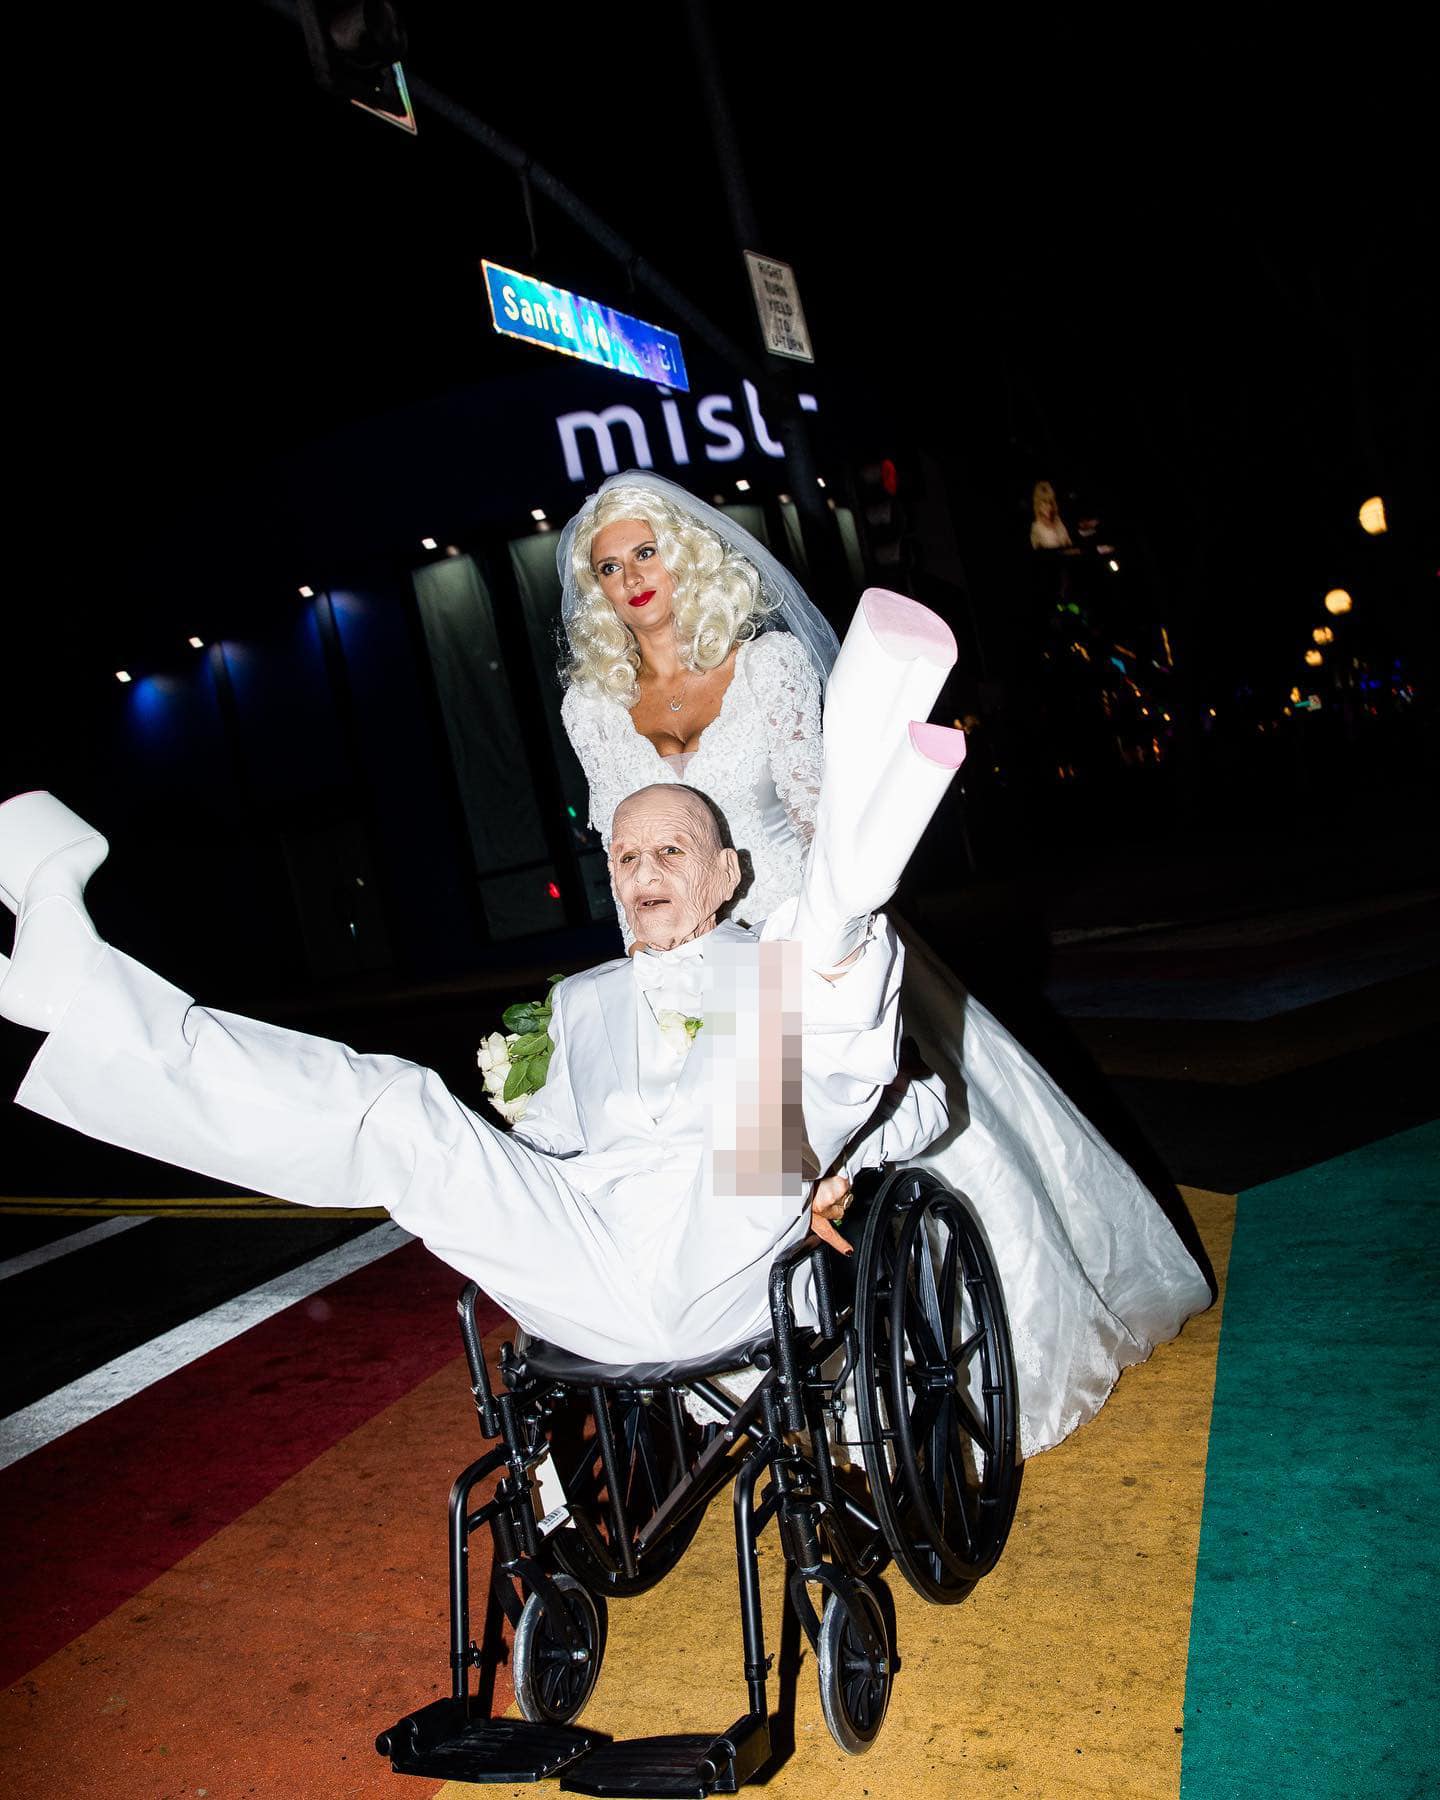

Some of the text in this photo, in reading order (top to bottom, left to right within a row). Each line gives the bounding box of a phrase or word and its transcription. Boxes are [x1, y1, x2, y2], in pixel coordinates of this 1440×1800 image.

[757, 261, 783, 280] RIGHT
[764, 280, 788, 297] TURN
[502, 285, 575, 340] Santa
[768, 299, 793, 316] YIELD
[778, 318, 791, 332] TO
[772, 333, 805, 352] U-TURN
[556, 378, 819, 482] mist
